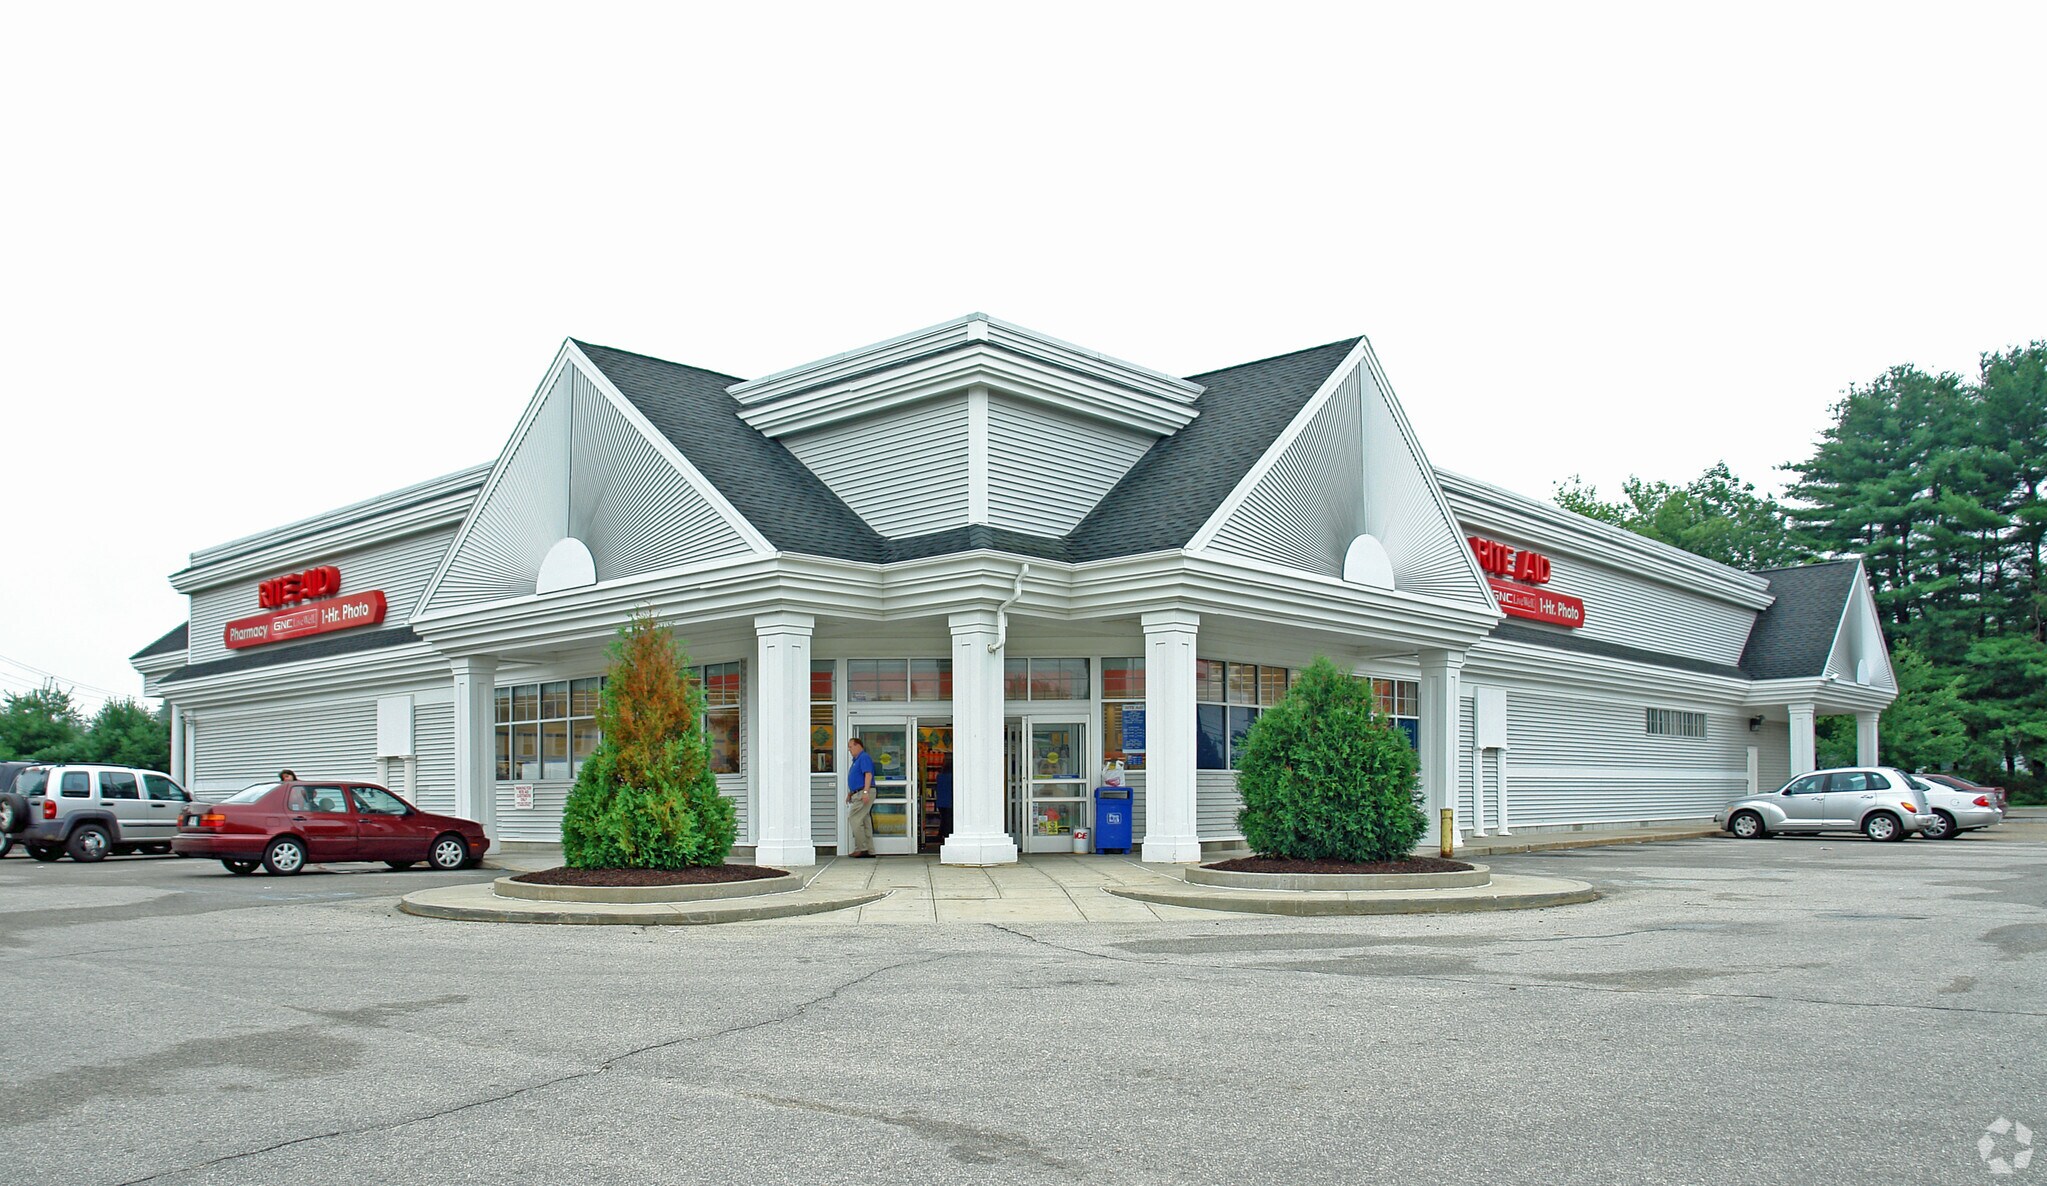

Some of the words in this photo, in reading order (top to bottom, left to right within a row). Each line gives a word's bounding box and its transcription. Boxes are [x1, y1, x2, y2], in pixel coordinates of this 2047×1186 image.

[1467, 536, 1516, 576] RITE
[1513, 550, 1551, 584] AID
[229, 623, 269, 643] Pharmacy
[273, 618, 293, 631] GNC
[321, 607, 340, 625] 1-Hr.
[342, 601, 369, 620] Photo
[1539, 597, 1557, 616] 1-Hr.
[1557, 602, 1580, 621] Photo
